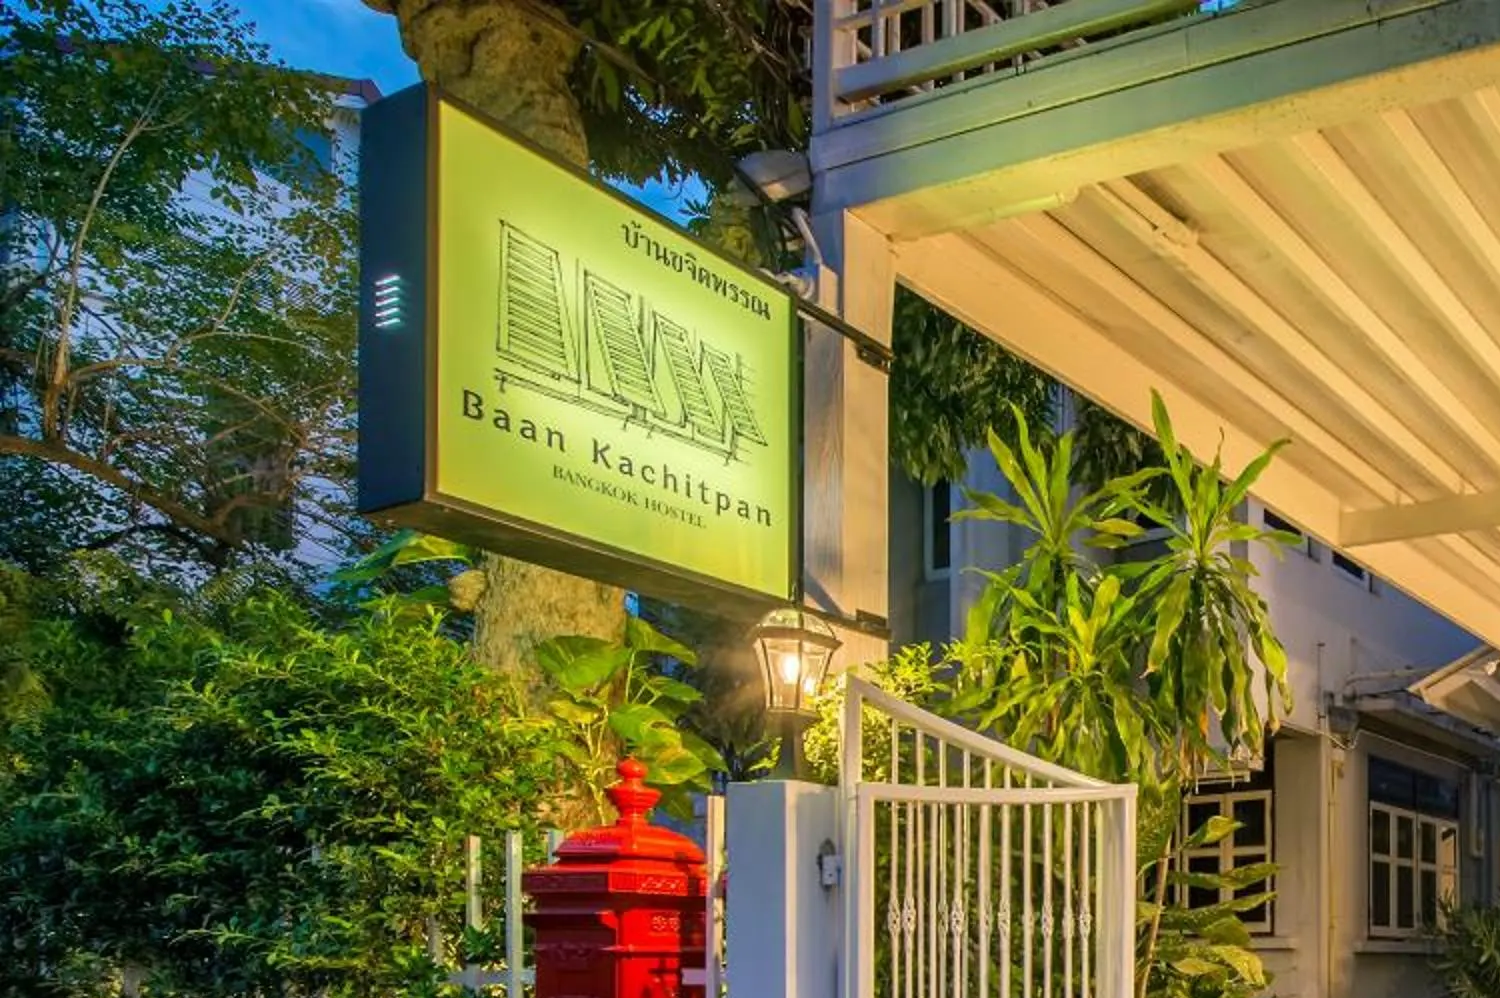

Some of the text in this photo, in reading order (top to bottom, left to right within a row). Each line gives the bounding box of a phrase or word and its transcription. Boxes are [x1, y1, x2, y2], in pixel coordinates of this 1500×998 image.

[463, 388, 772, 526] Baan Kachitpan
[552, 463, 707, 529] BANGKOK HOSTEL
